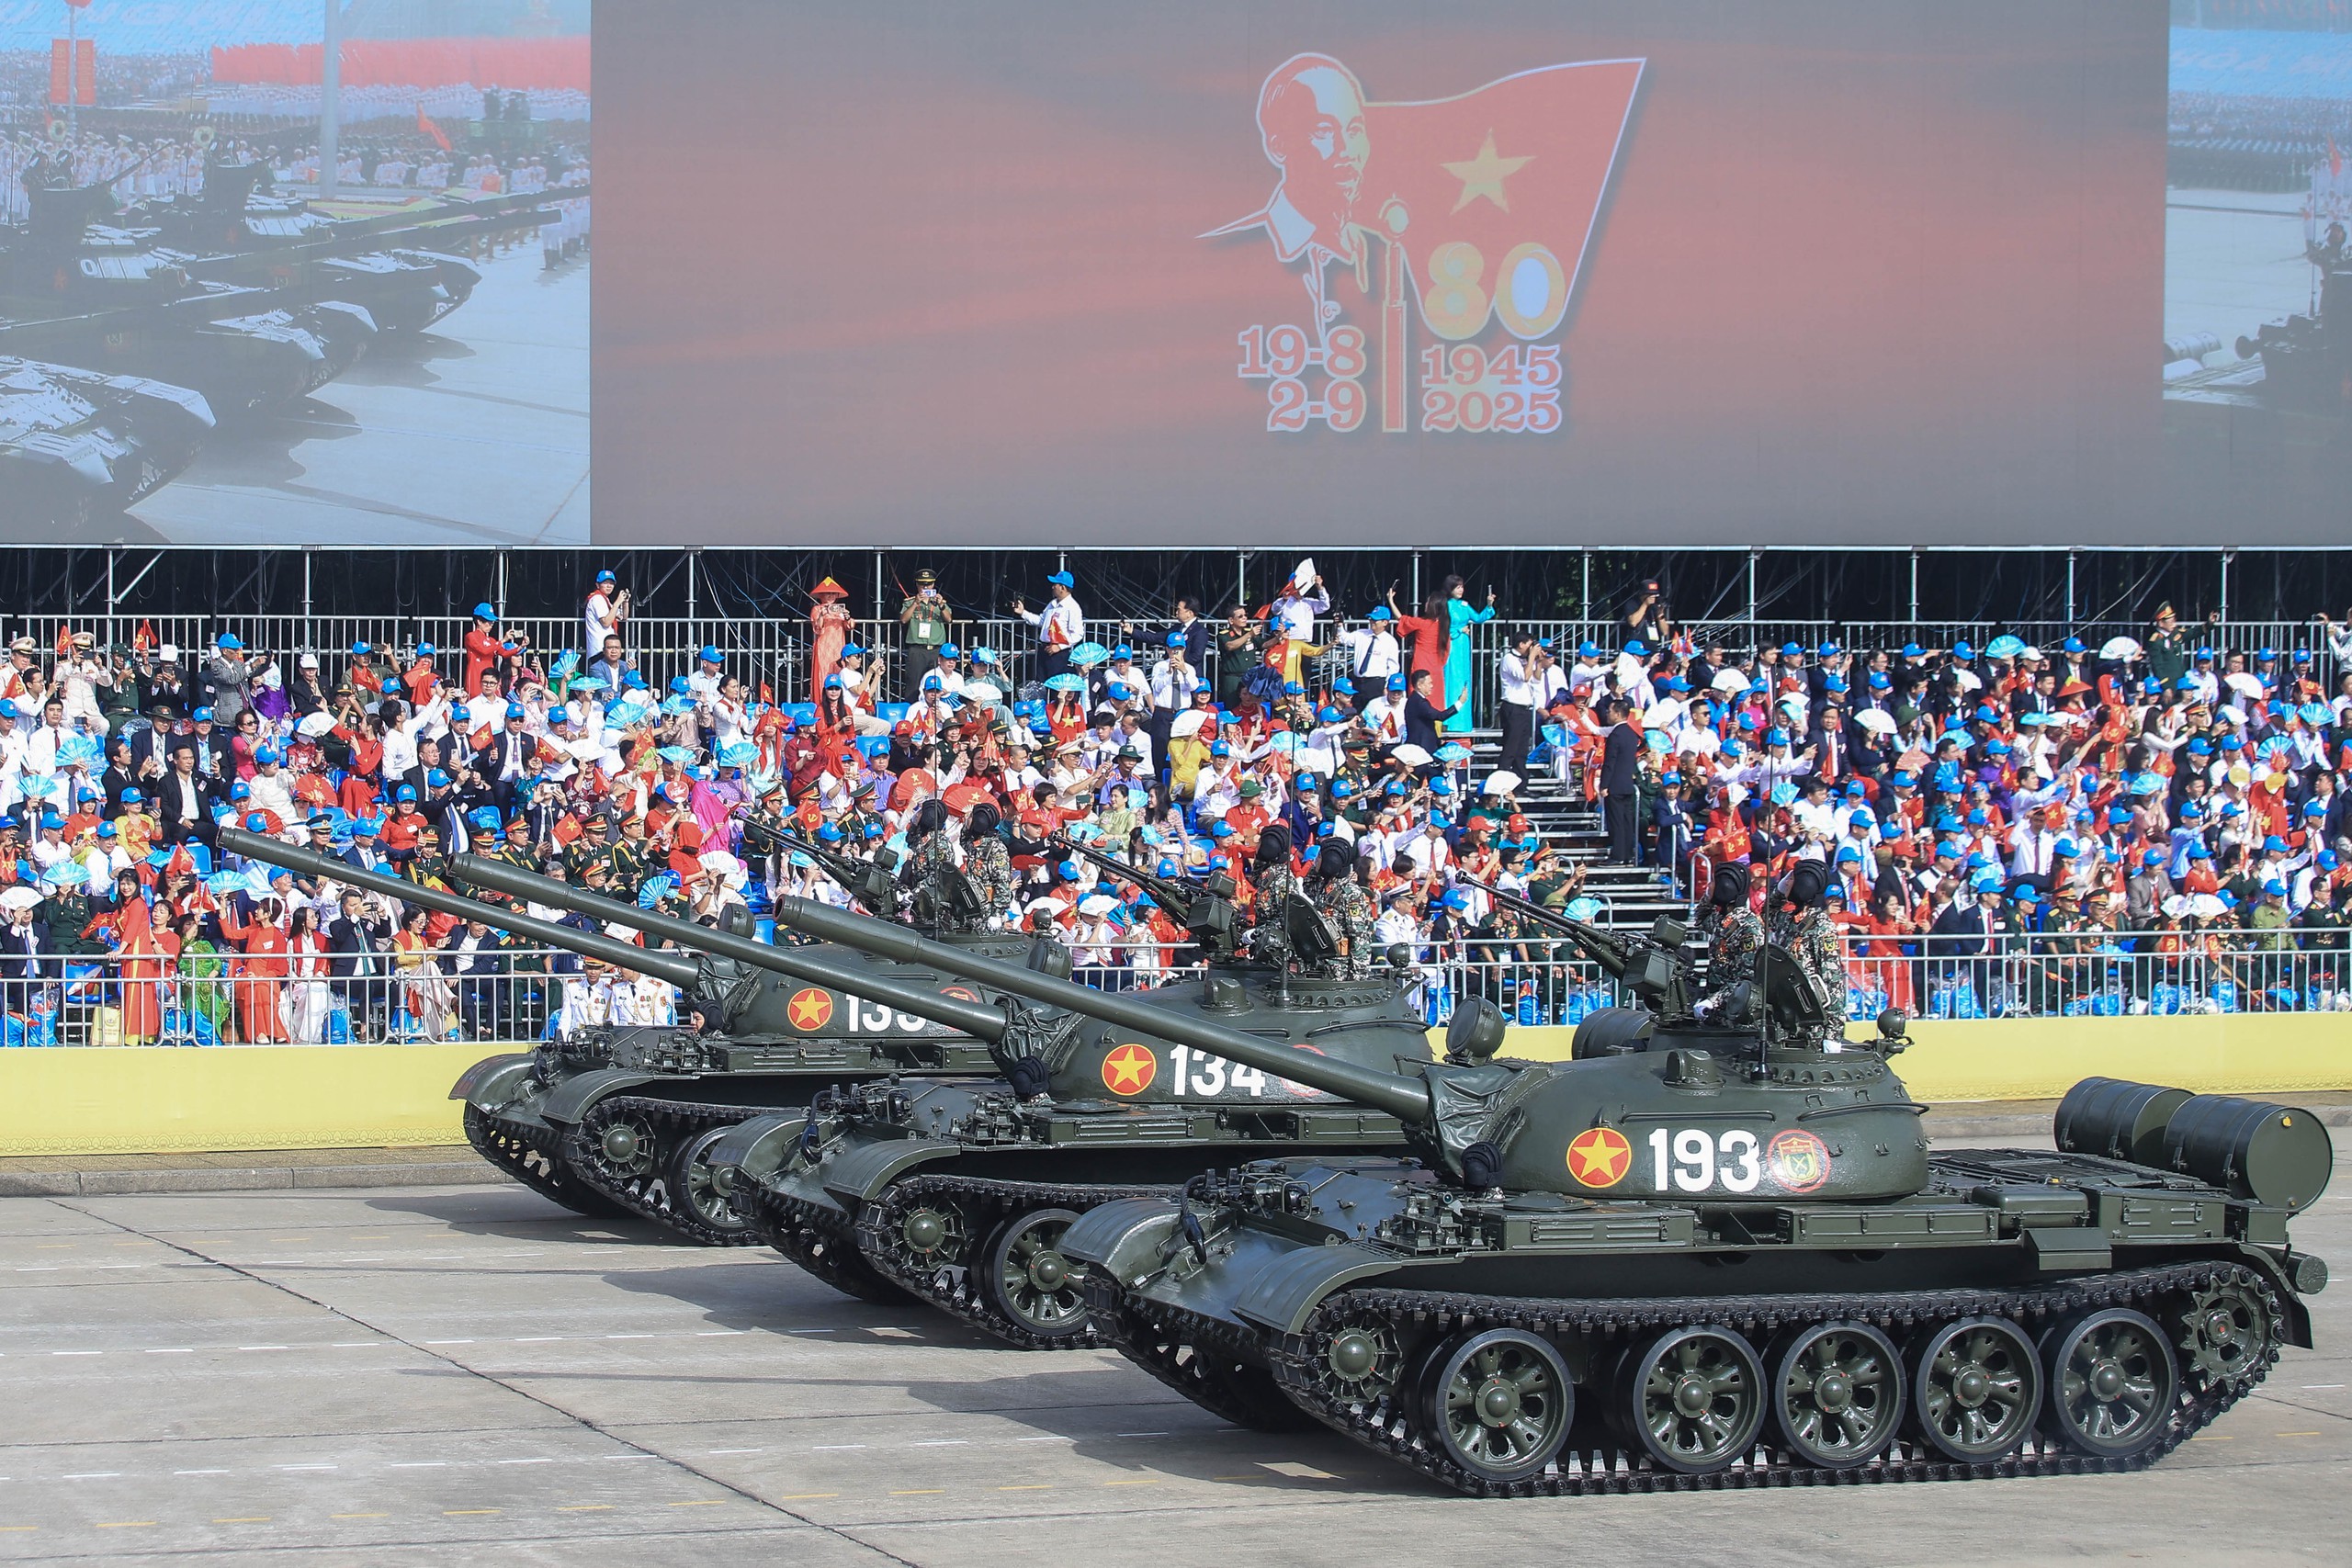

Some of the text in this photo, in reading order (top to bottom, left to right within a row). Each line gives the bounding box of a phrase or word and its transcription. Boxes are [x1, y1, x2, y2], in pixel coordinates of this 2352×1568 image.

[1424, 243, 1566, 340] 80
[1238, 325, 1366, 378] 19-8
[1421, 344, 1561, 388] 1945
[1267, 378, 1367, 433] 2-9
[1421, 388, 1562, 434] 2025
[1170, 1043, 1266, 1097] 134
[1648, 1128, 1760, 1193] 193
